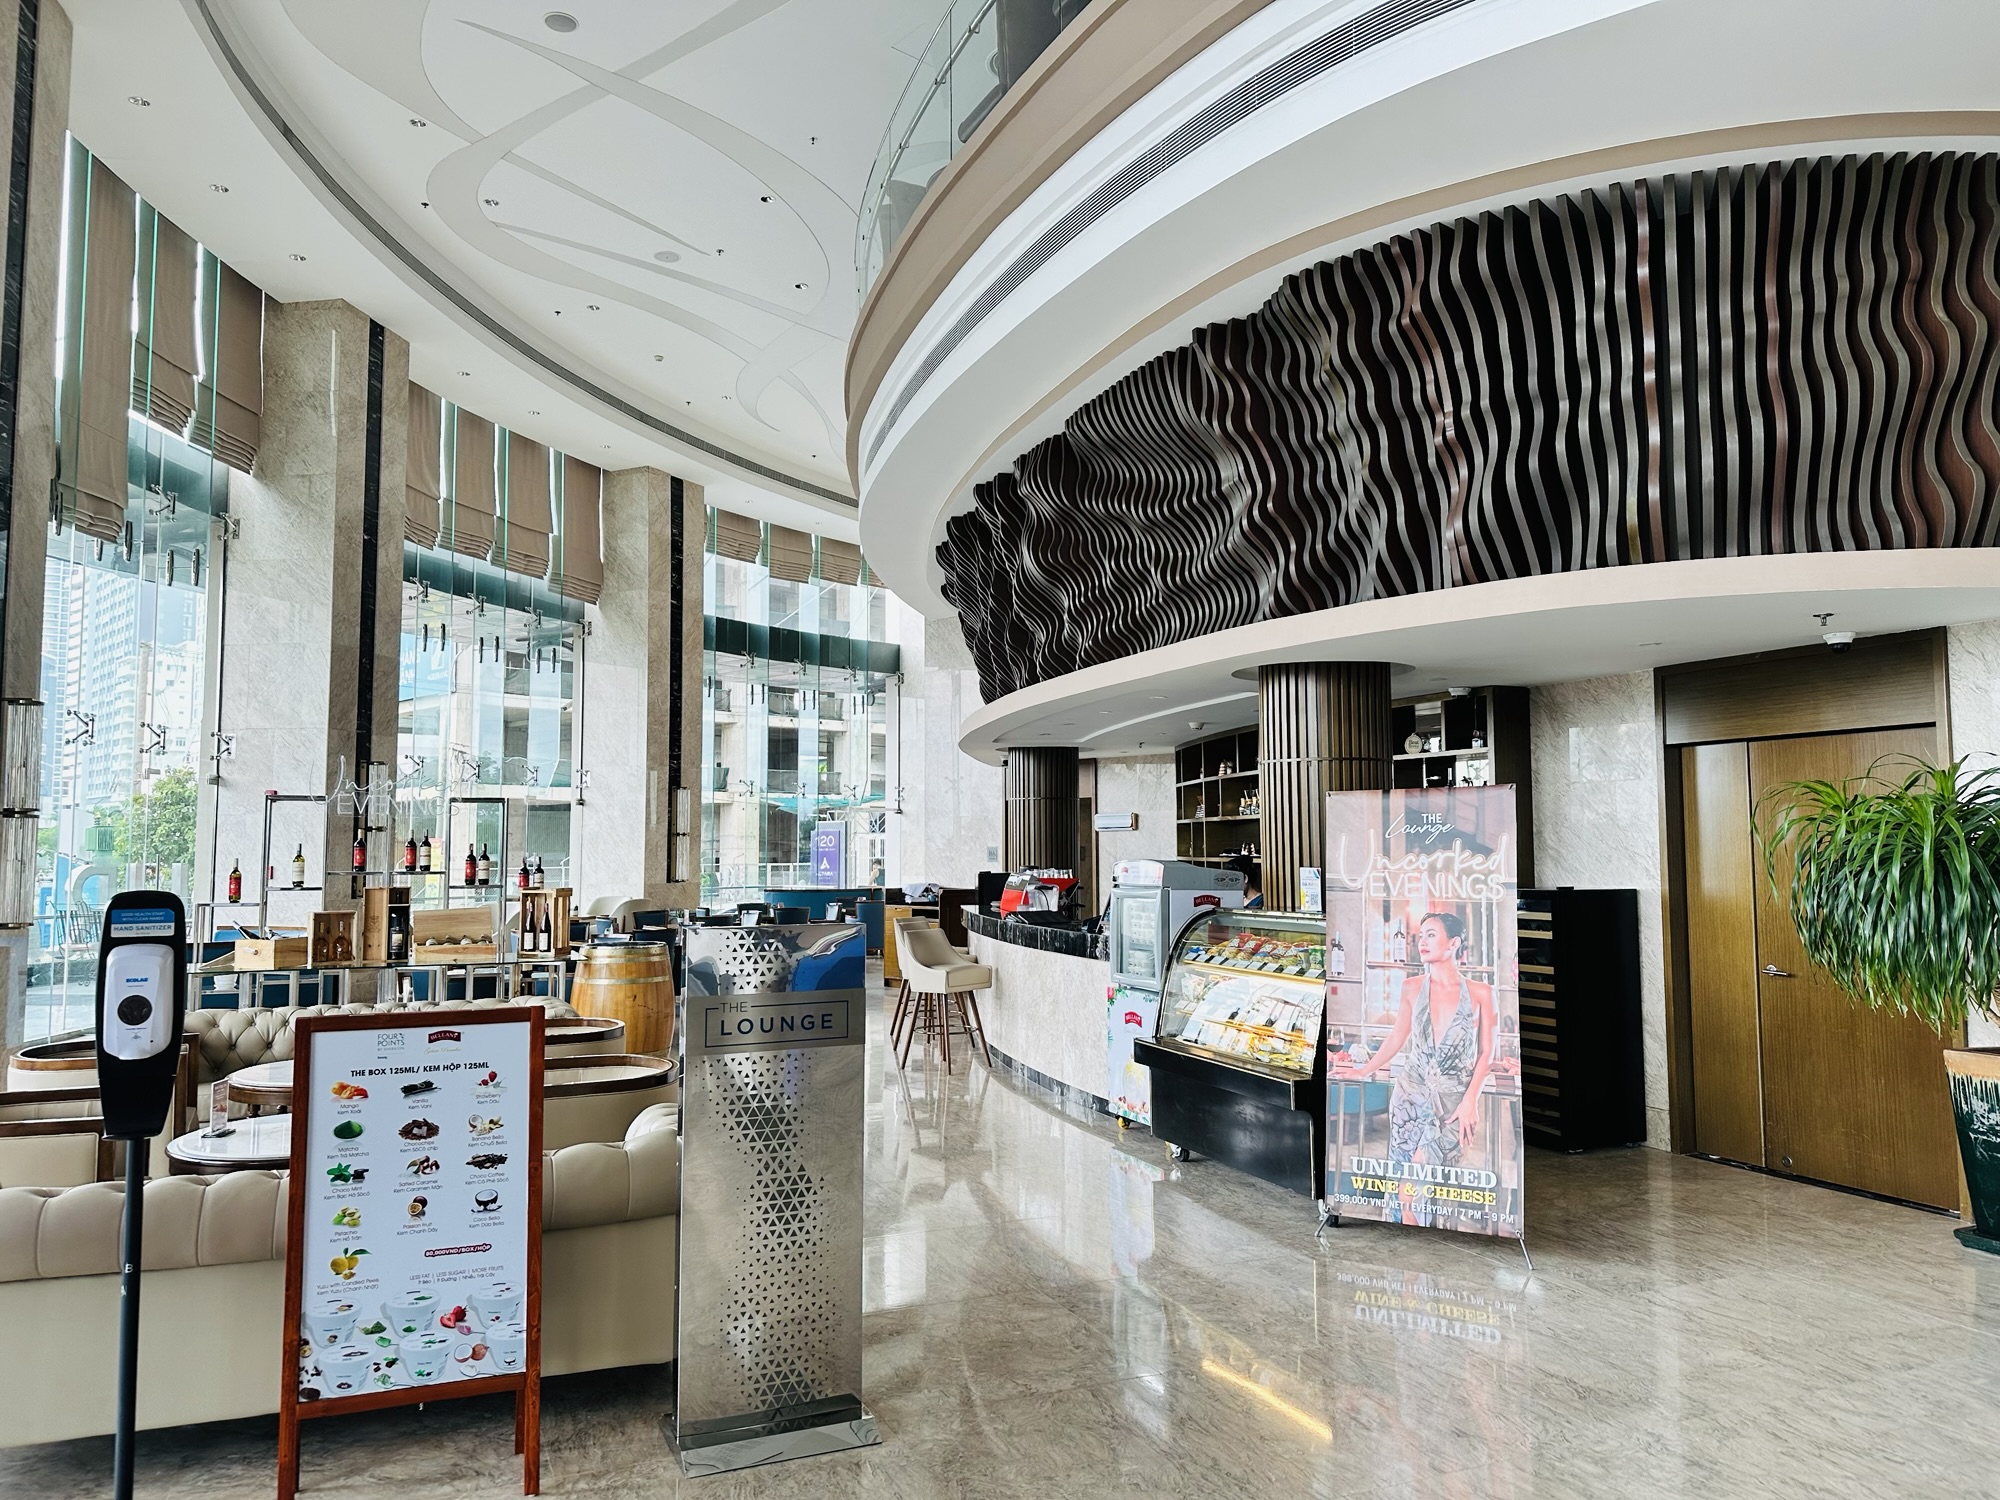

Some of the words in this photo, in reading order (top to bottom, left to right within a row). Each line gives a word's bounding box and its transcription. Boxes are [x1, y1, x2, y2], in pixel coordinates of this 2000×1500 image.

[1385, 813, 1455, 844] Lounge
[1422, 813, 1442, 824] THE
[1339, 829, 1509, 889] Uncorked
[1368, 871, 1505, 900] EVENINGS
[720, 1002, 748, 1013] THE
[378, 1032, 399, 1040] FOUR
[720, 1014, 833, 1036] LOUNGE
[368, 1068, 386, 1076] BOX
[390, 1066, 420, 1074] 125ML/
[423, 1064, 440, 1072] KEM
[442, 1062, 461, 1072] HỘP
[464, 1061, 489, 1069] 125ML
[1350, 1156, 1498, 1188] UNLIMITED
[1350, 1176, 1399, 1194] WINE
[1403, 1183, 1418, 1197] &
[1423, 1184, 1496, 1206] CHEESE
[1370, 1198, 1387, 1208] VND
[1389, 1200, 1405, 1210] NET
[1412, 1202, 1453, 1216] EVERYDAY
[1460, 1208, 1466, 1218] 7
[1468, 1210, 1482, 1220] PM
[1492, 1212, 1498, 1222] 9
[1500, 1213, 1514, 1224] PM
